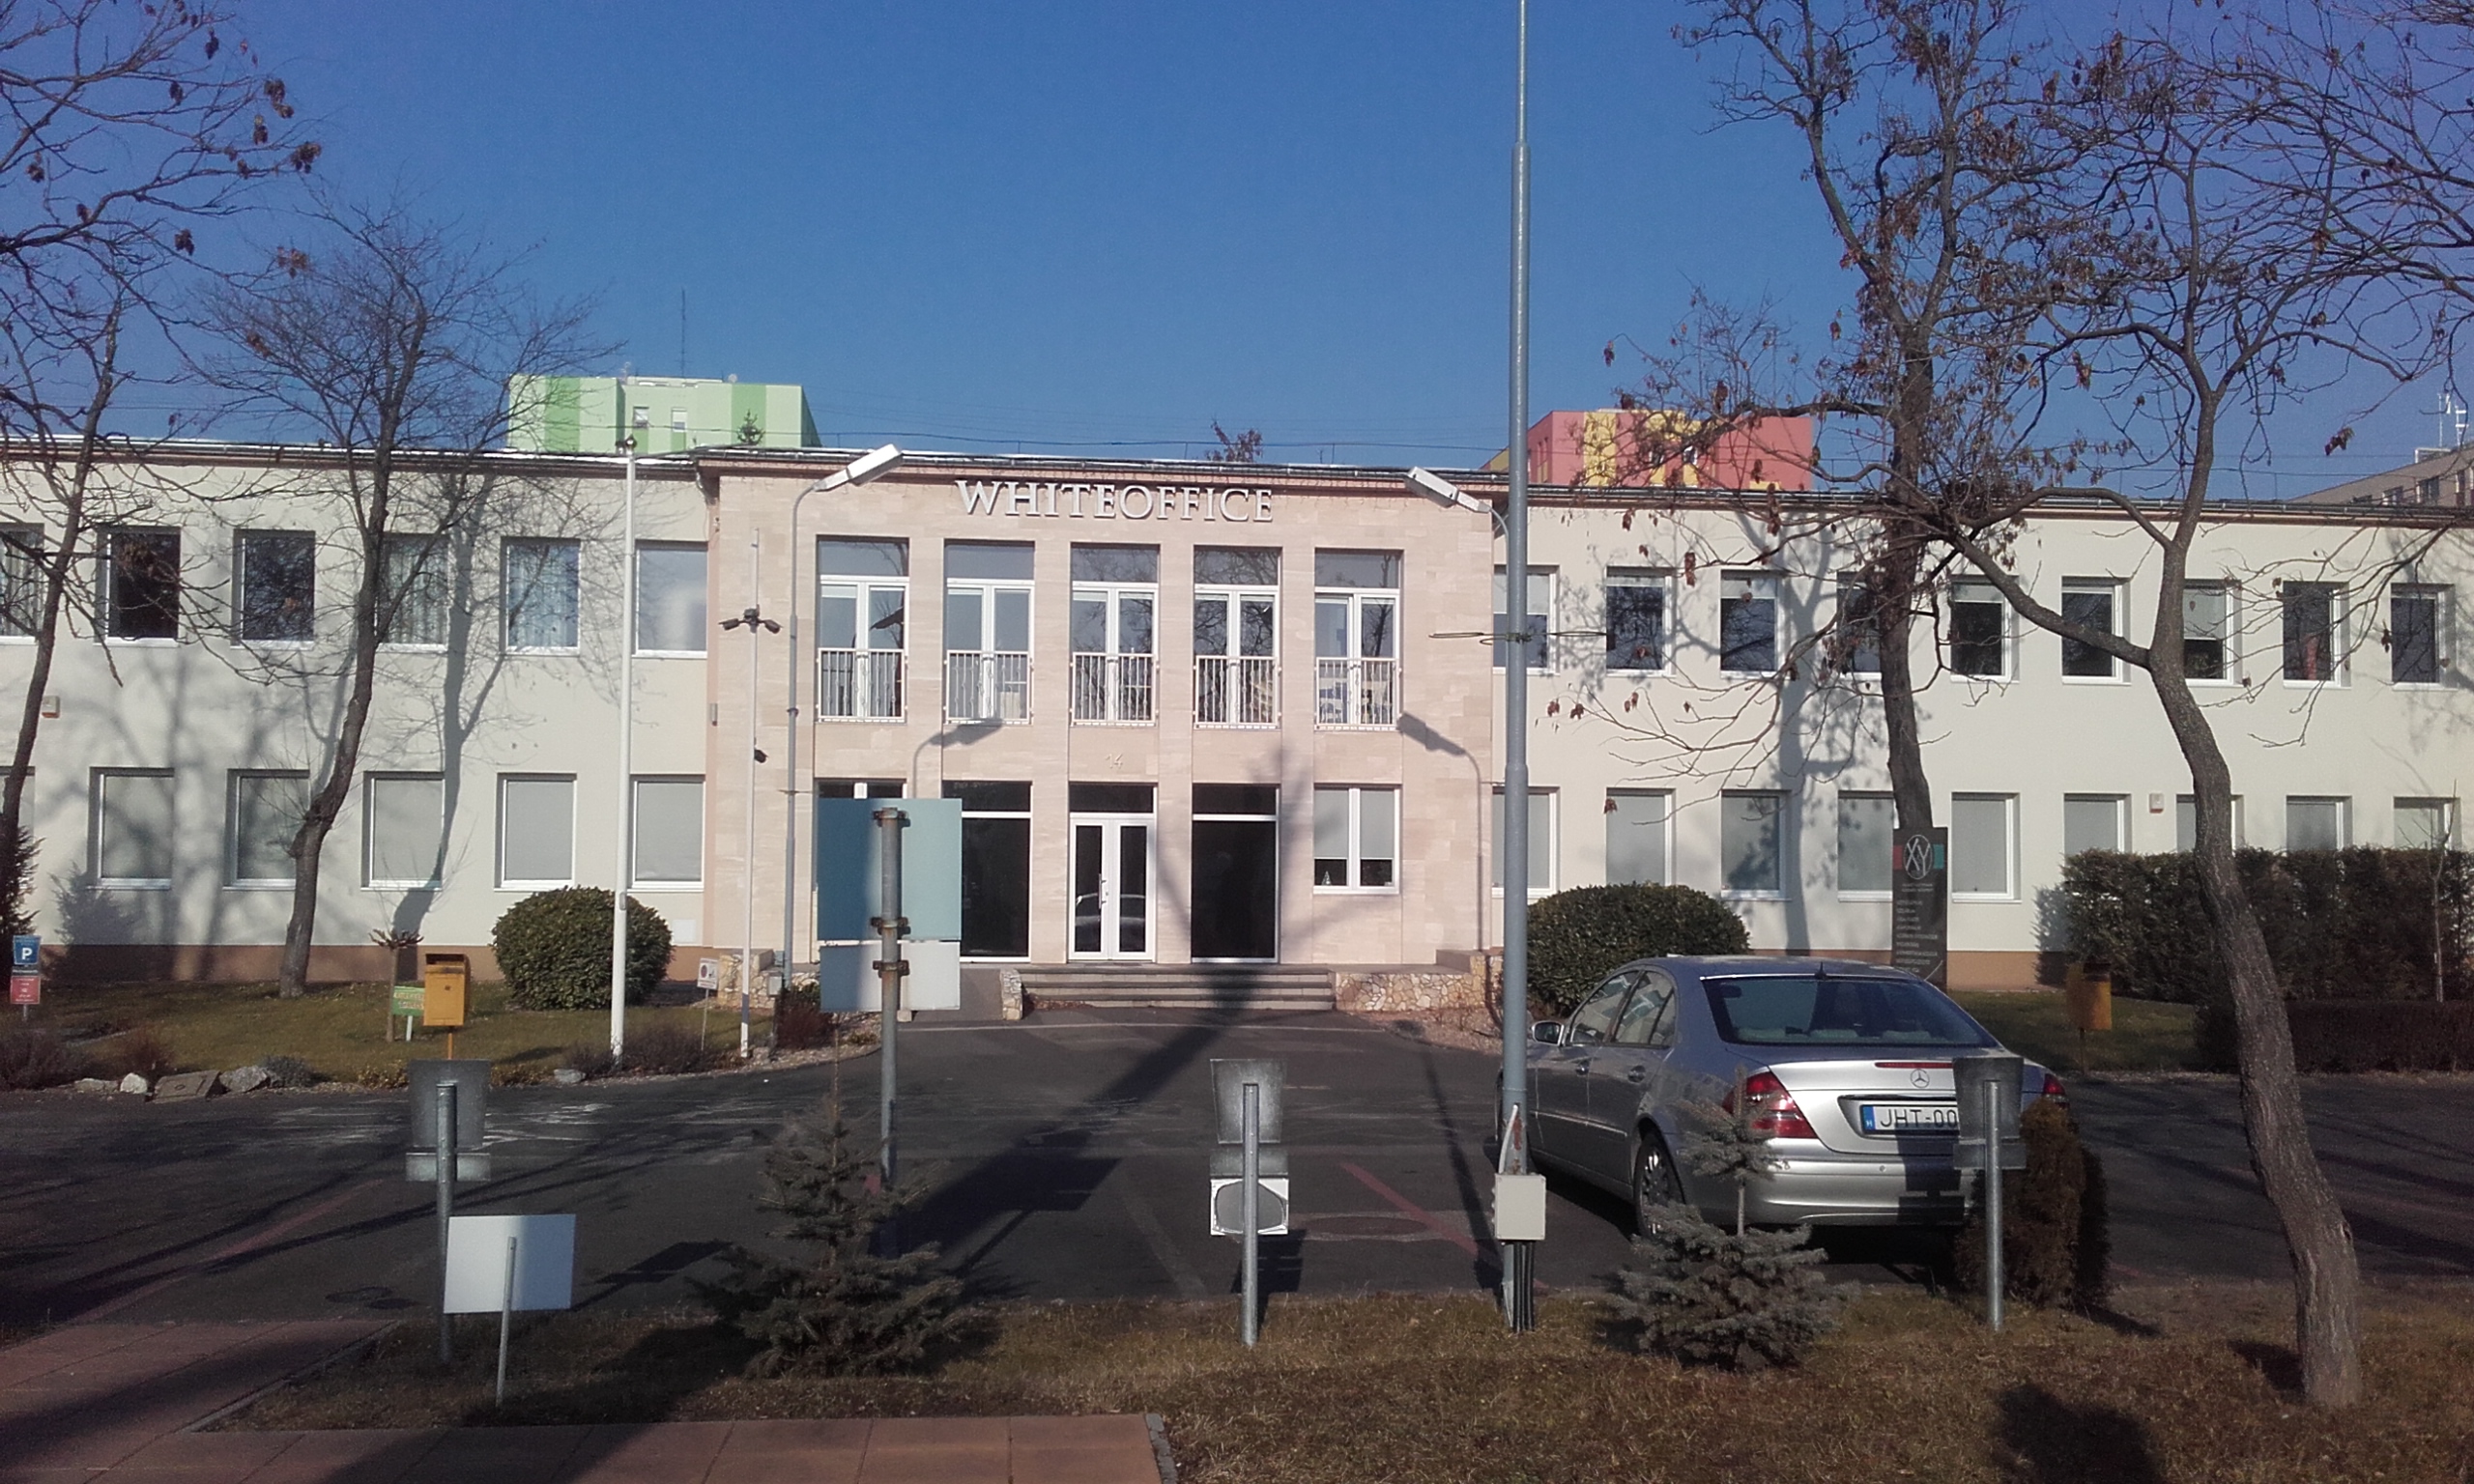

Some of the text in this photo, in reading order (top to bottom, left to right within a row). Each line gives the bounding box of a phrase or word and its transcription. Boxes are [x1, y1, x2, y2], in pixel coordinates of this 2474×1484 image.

[955, 480, 1273, 522] WHITEOFFICE
[1105, 753, 1123, 770] 14
[22, 947, 33, 960] P
[1880, 1109, 1958, 1128] JHT-00
